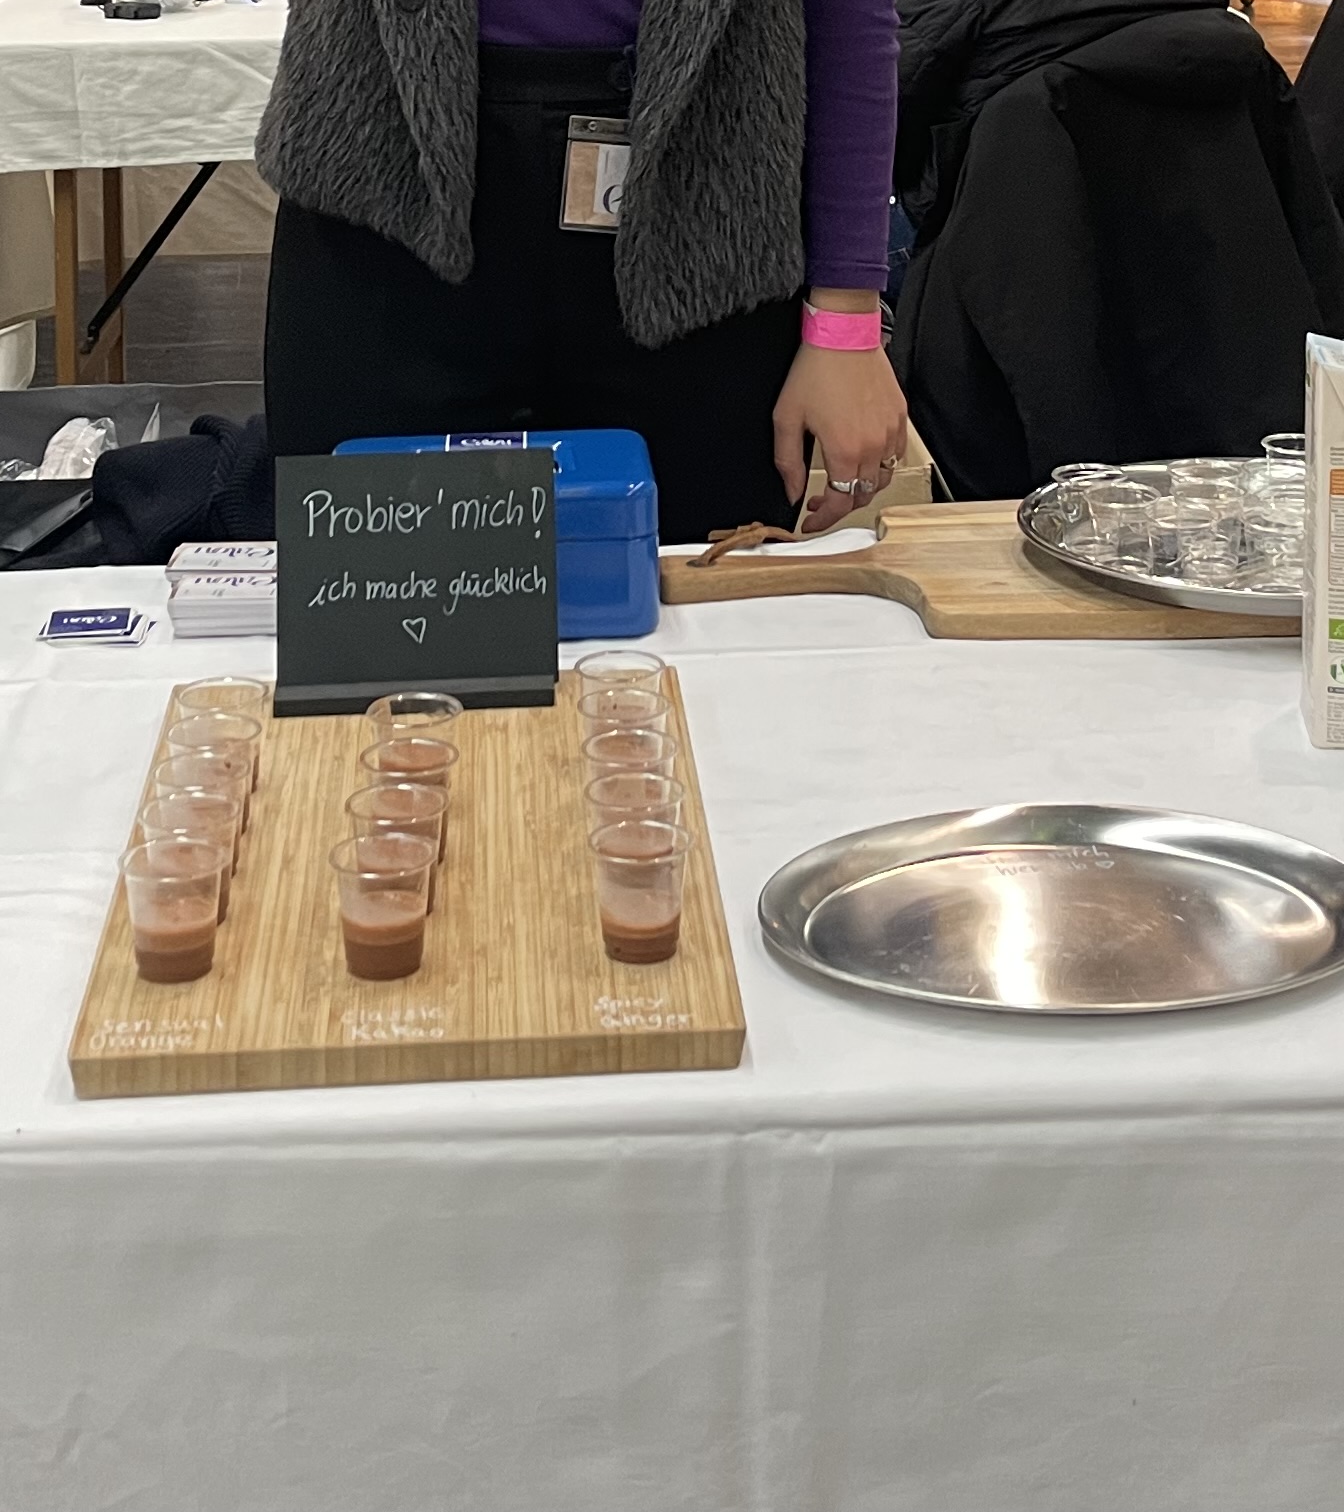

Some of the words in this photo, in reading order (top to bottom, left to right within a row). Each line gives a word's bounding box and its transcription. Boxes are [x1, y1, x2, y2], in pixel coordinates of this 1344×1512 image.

[308, 571, 357, 607] ich
[365, 571, 437, 600] mache
[443, 565, 547, 616] glücklich
